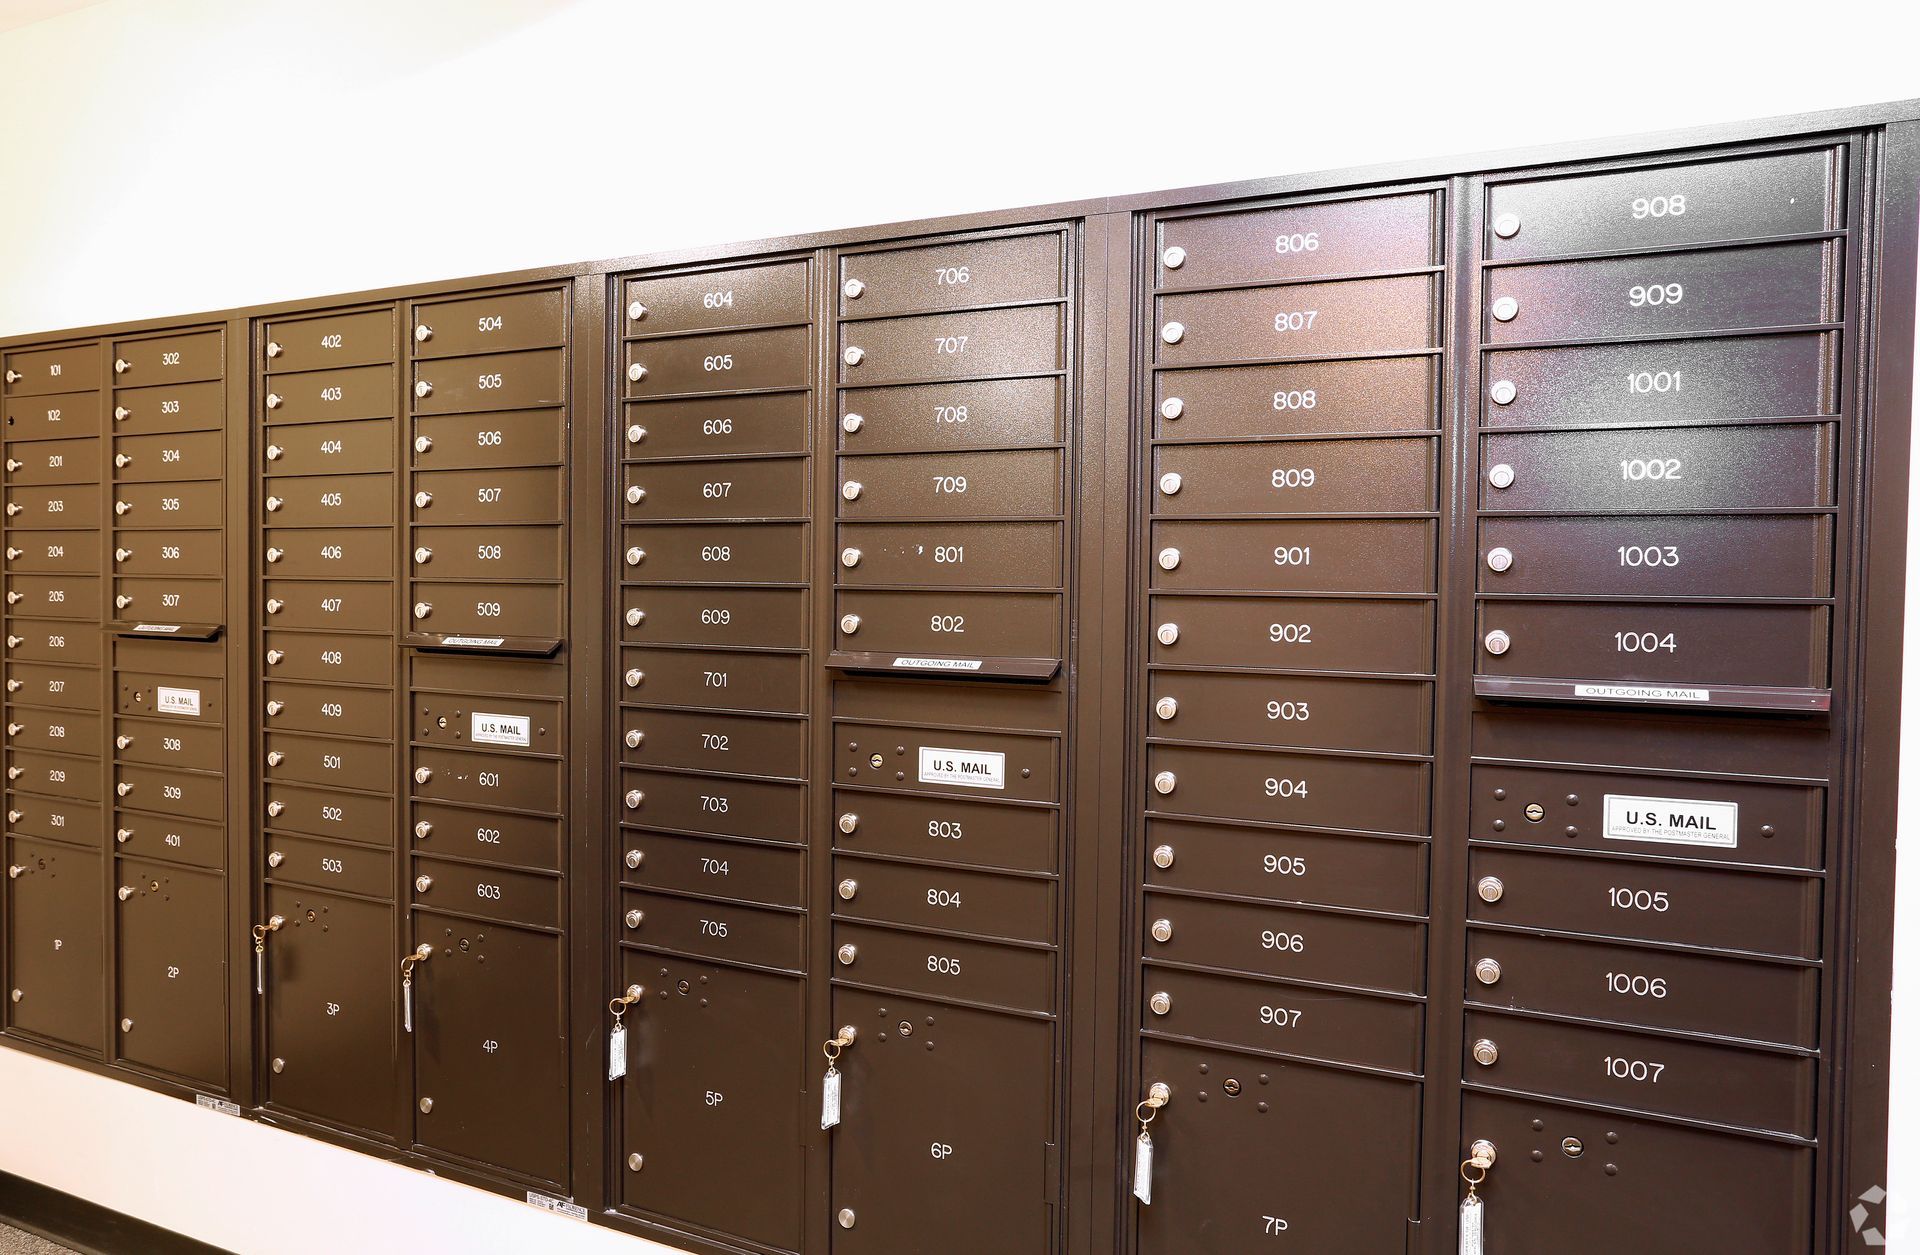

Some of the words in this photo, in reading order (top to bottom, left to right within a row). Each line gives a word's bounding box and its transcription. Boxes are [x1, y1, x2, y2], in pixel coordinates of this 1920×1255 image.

[1631, 194, 1686, 219] 908
[1275, 232, 1320, 254] 806
[935, 266, 970, 285] 706
[703, 290, 733, 309] 604
[1628, 282, 1683, 308] 909
[478, 315, 503, 332] 504
[1274, 310, 1318, 332] 807
[321, 334, 342, 348] 402
[935, 335, 969, 354] 707
[162, 352, 180, 366] 302
[703, 354, 733, 372] 605
[50, 364, 61, 376] 101
[478, 373, 502, 390] 505
[1626, 370, 1681, 394] 1001
[320, 387, 342, 401] 403
[1273, 389, 1316, 411] 808
[47, 409, 61, 421] 102
[161, 400, 180, 414] 303
[934, 405, 968, 423] 708
[703, 418, 732, 435] 606
[478, 430, 502, 446] 506
[320, 440, 342, 454] 404
[49, 455, 63, 468] 201
[162, 449, 180, 463] 304
[1620, 458, 1682, 481] 1002
[933, 476, 967, 493] 709
[1271, 468, 1315, 488] 809
[478, 488, 502, 503] 507
[702, 482, 732, 498] 607
[48, 500, 64, 512] 203
[162, 498, 180, 511] 305
[320, 492, 342, 507] 405
[47, 545, 64, 558] 204
[162, 546, 180, 559] 306
[320, 545, 342, 559] 406
[478, 545, 501, 560] 508
[701, 546, 731, 562] 608
[934, 546, 963, 563] 801
[1274, 546, 1310, 566] 901
[1617, 545, 1680, 567] 1003
[48, 590, 65, 602] 205
[162, 594, 180, 607] 307
[321, 598, 342, 612] 407
[477, 602, 501, 617] 509
[701, 609, 730, 625] 609
[930, 615, 964, 633] 802
[1269, 623, 1312, 643] 902
[49, 635, 65, 648] 206
[1614, 631, 1677, 653] 1004
[321, 651, 342, 665] 408
[901, 659, 951, 668] OUTGOING
[952, 661, 974, 669] MAIL
[49, 680, 65, 692] 207
[703, 671, 727, 687] 701
[164, 696, 176, 704] U.S.
[178, 697, 193, 706] MAIL
[1585, 687, 1662, 698] OUTGOING
[1666, 690, 1700, 699] MAIL
[321, 703, 342, 717] 409
[1266, 700, 1310, 721] 903
[49, 725, 65, 738] 208
[481, 723, 498, 734] U.S.
[500, 724, 521, 735] MAIL
[163, 737, 181, 751] 308
[701, 733, 729, 751] 702
[323, 755, 341, 769] 501
[933, 760, 957, 772] U.S.
[961, 762, 992, 775] MAIL
[49, 769, 66, 783] 209
[479, 771, 499, 787] 601
[163, 785, 182, 800] 309
[1264, 777, 1308, 799] 904
[701, 795, 729, 813] 703
[50, 814, 65, 827] 301
[322, 806, 342, 821] 502
[1626, 811, 1662, 827] U.S.
[1669, 814, 1717, 830] MAIL
[477, 828, 500, 844] 602
[928, 820, 962, 839] 803
[1612, 826, 1643, 835] APPROVED
[1652, 828, 1663, 836] THE
[1663, 829, 1702, 838] POSTMASTER
[1703, 832, 1730, 841] GENERAL
[165, 834, 181, 847] 401
[322, 858, 343, 873] 503
[701, 857, 729, 875] 704
[1263, 854, 1306, 876] 905
[477, 883, 501, 900] 603
[927, 888, 961, 908] 804
[1608, 887, 1669, 912] 1005
[700, 919, 728, 938] 705
[1261, 930, 1304, 953] 906
[167, 965, 180, 979] 2P
[927, 955, 961, 976] 805
[1605, 972, 1667, 999] 1006
[326, 1002, 340, 1016] 3P
[1260, 1005, 1302, 1028] 907
[482, 1039, 498, 1054] 4P
[1604, 1056, 1665, 1083] 1007
[705, 1090, 723, 1106] 5P
[930, 1142, 953, 1160] 6P
[1262, 1215, 1288, 1236] 7P
